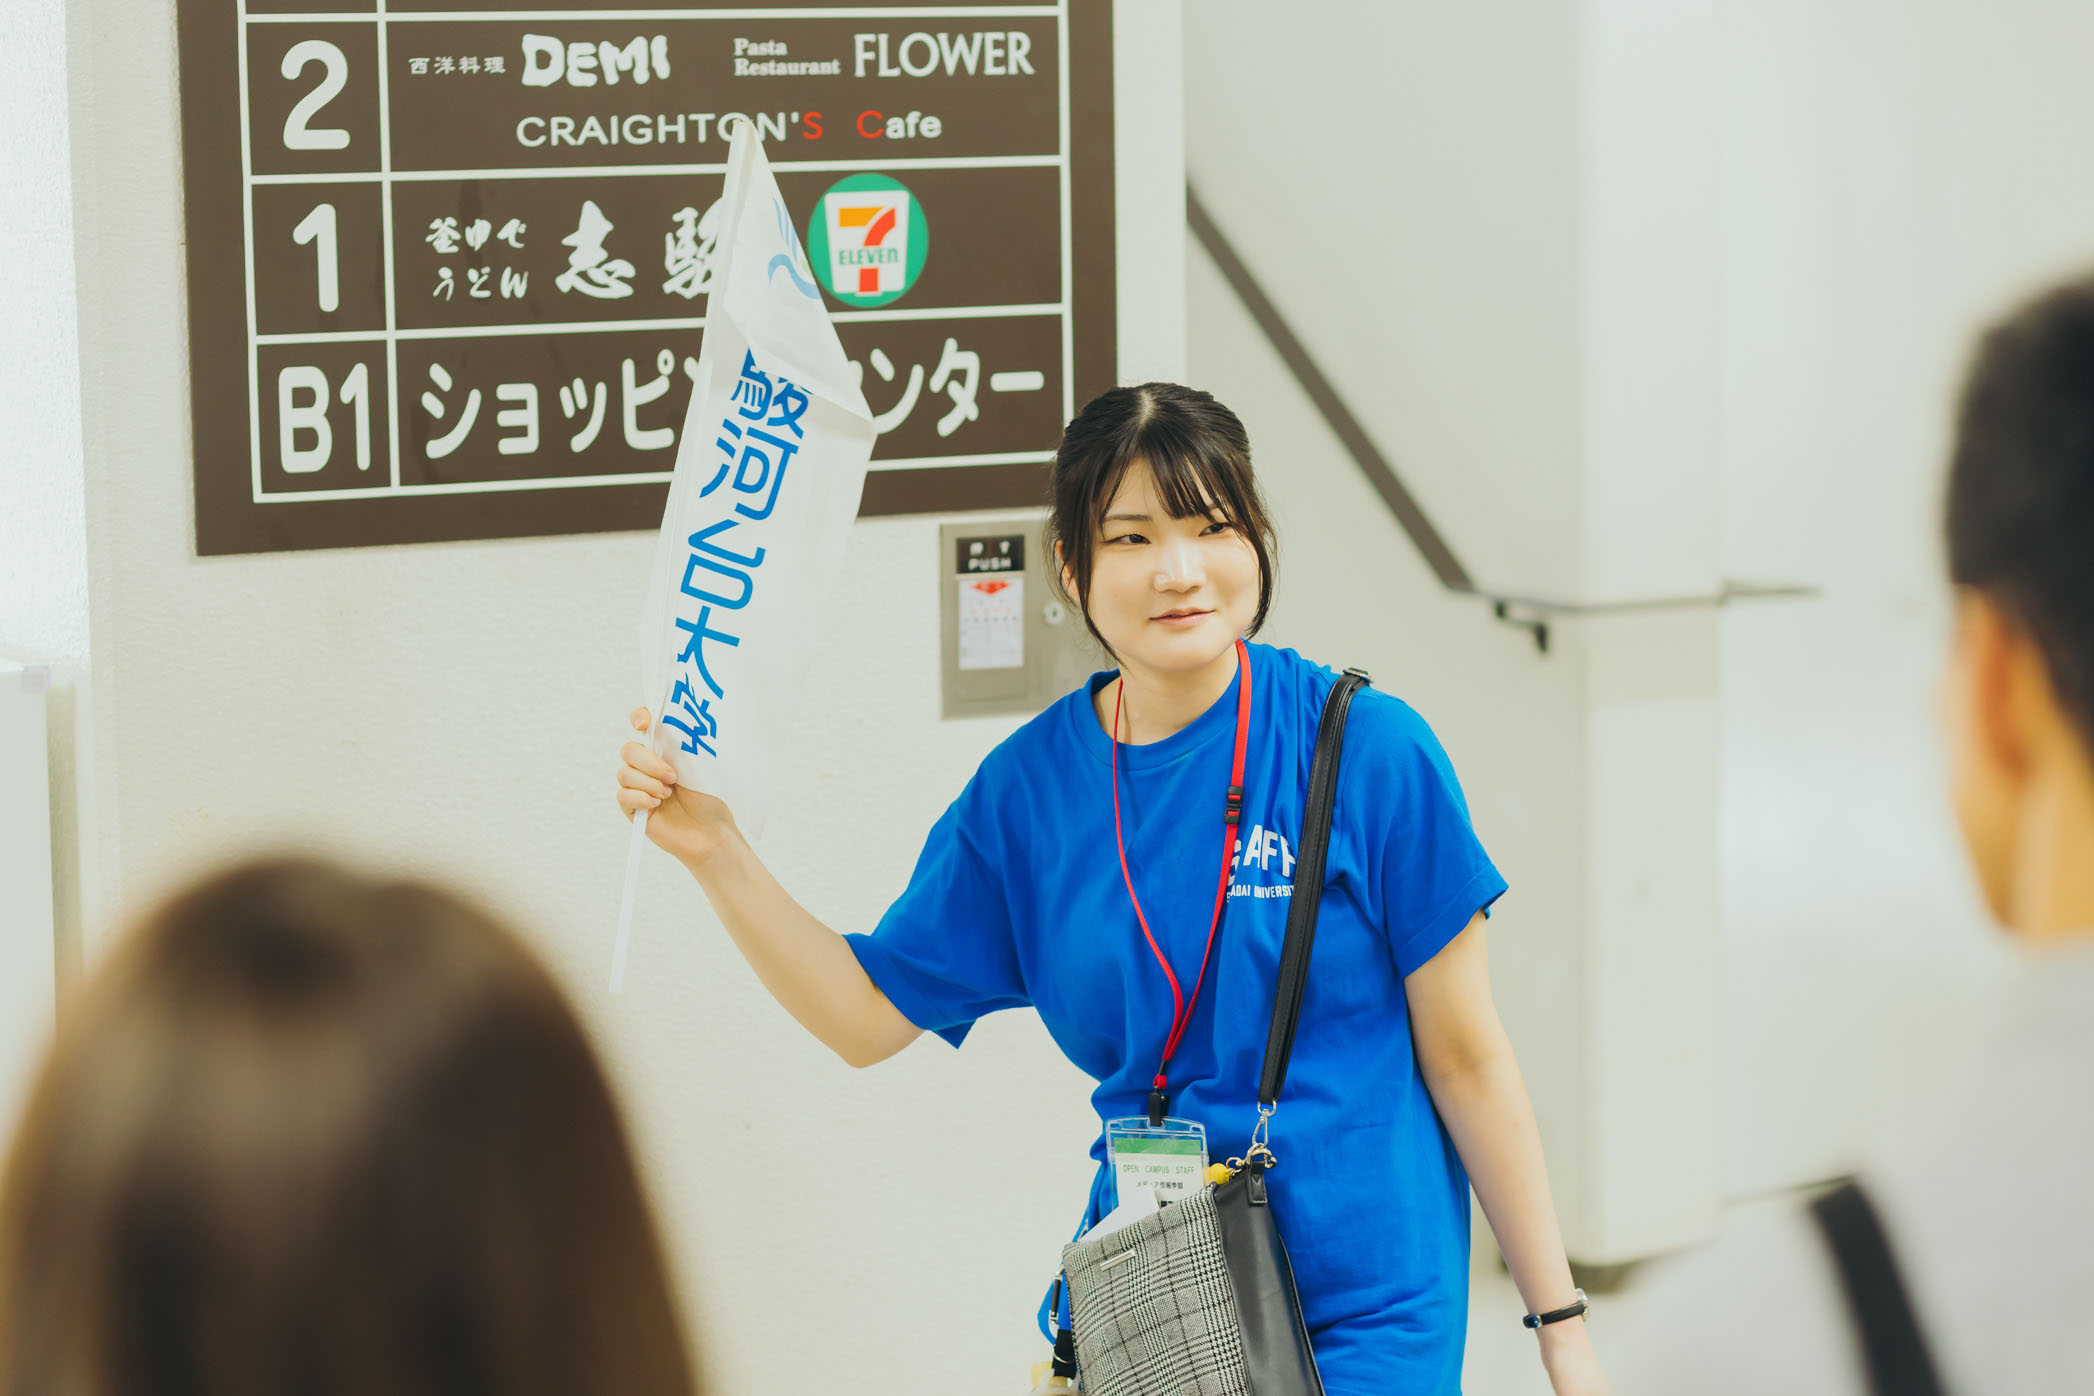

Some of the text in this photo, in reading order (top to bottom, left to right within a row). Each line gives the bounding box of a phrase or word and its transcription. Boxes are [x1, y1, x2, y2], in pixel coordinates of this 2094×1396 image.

[408, 56, 506, 75] 西洋料理
[521, 33, 671, 87] DEMI
[734, 37, 788, 56] Pasta
[854, 31, 1035, 77] FLOWER
[734, 58, 841, 77] Restaurant
[280, 39, 350, 150] 2
[516, 110, 942, 147] CRAIGHTON'S Cafe
[425, 216, 527, 254] 釜ゆで
[838, 206, 896, 293] 7
[292, 203, 339, 312] 1
[433, 266, 529, 301] うどん
[278, 362, 371, 473] B1
[1123, 1164, 1195, 1175] OPEN CAMPUS STAFF
